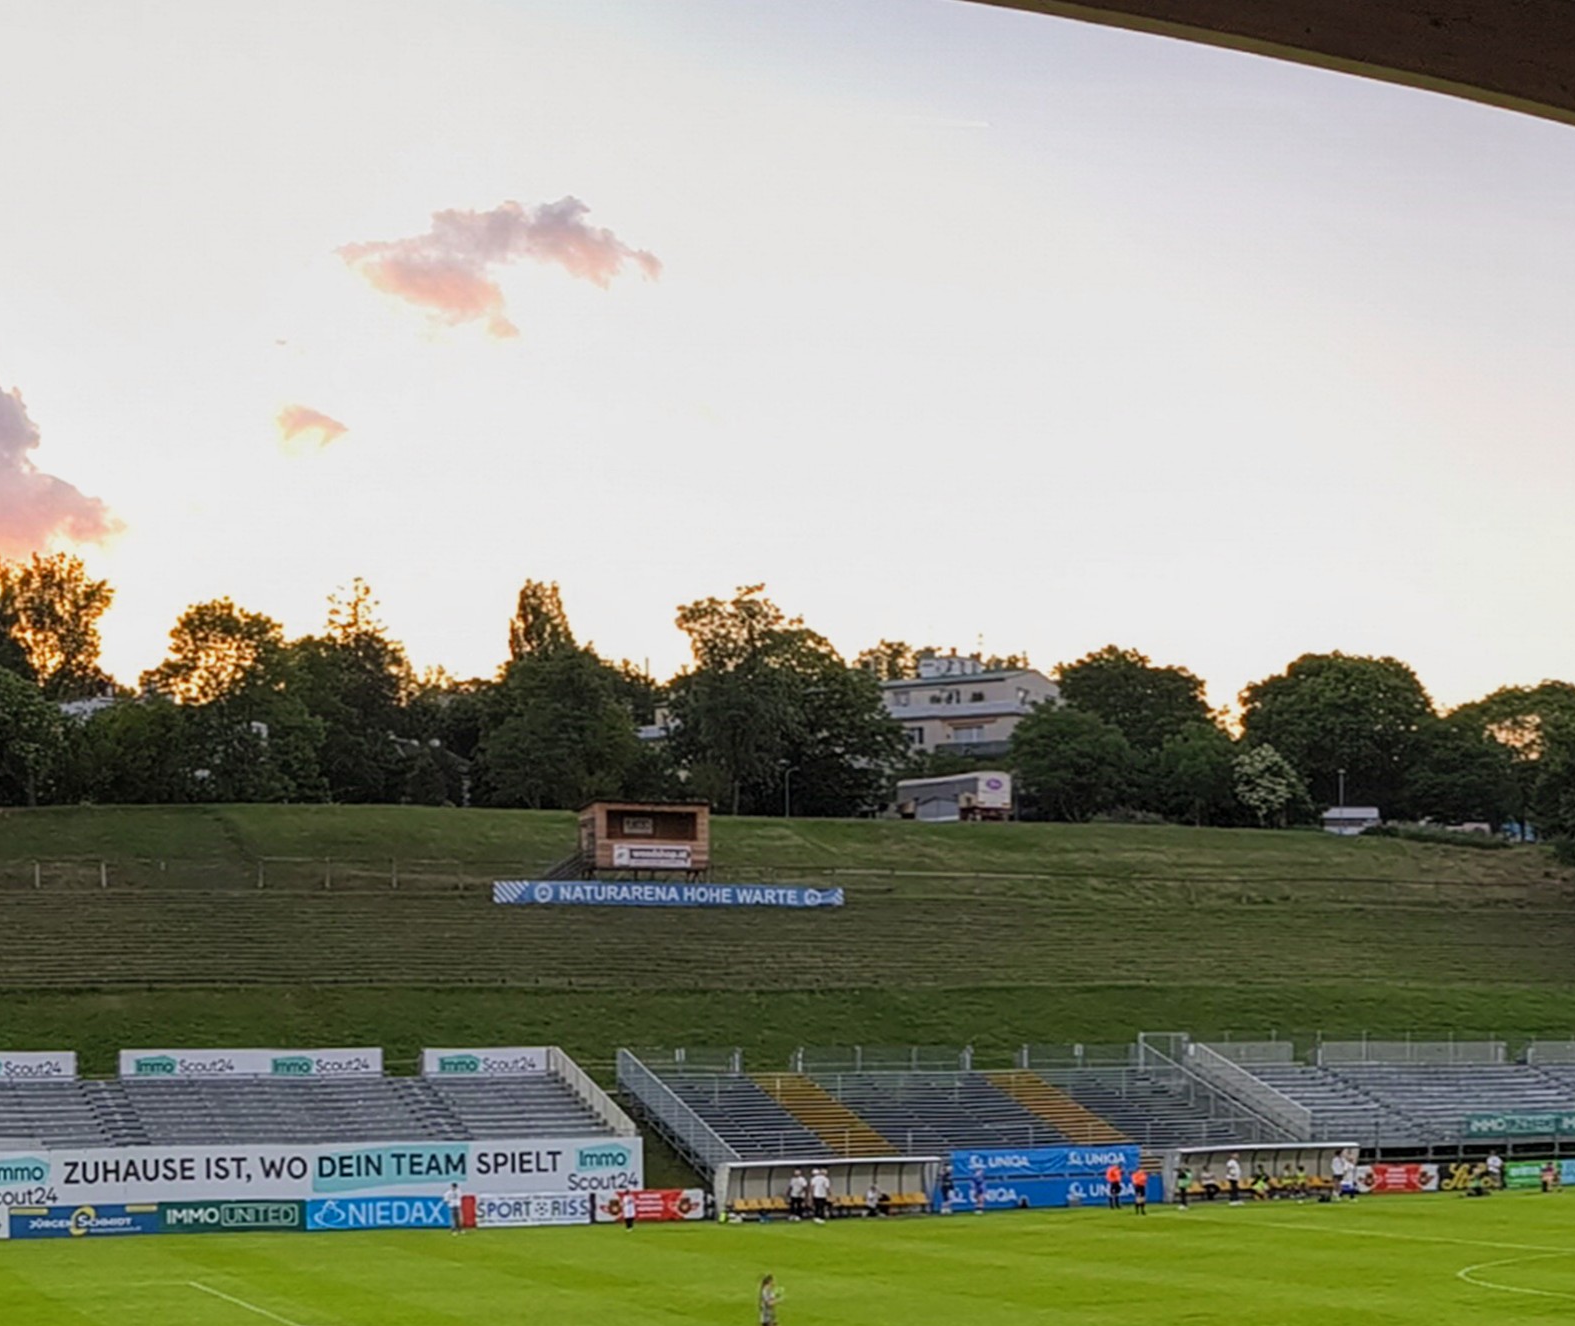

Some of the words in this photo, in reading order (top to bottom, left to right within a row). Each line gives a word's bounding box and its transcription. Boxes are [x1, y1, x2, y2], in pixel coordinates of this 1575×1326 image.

[559, 884, 679, 902] NATURARENA
[683, 887, 732, 903] HOHE
[736, 888, 797, 905] WARTE
[4, 1061, 62, 1077] Scout24
[136, 1058, 175, 1074] Immo
[179, 1058, 235, 1073] Scout24
[272, 1058, 312, 1073] Immo
[315, 1057, 370, 1073] Scout24
[439, 1057, 477, 1073] Immo
[482, 1056, 537, 1072] Scout24
[579, 1150, 626, 1167] Immo
[988, 1156, 1029, 1167] UNIQA
[1085, 1152, 1126, 1165] UNIQA
[63, 1157, 195, 1185] ZUHAUSE
[205, 1157, 252, 1183] IST,
[260, 1156, 308, 1179] WO
[318, 1153, 383, 1178] DEIN
[391, 1152, 467, 1176] TEAM
[476, 1150, 562, 1175] SPIELT
[568, 1173, 639, 1192] Scout24
[166, 1208, 220, 1225] IMMO
[225, 1206, 295, 1225] UNITED
[348, 1199, 445, 1225] NIEDAX
[476, 1200, 533, 1219] SPORT
[551, 1199, 590, 1218] RISS
